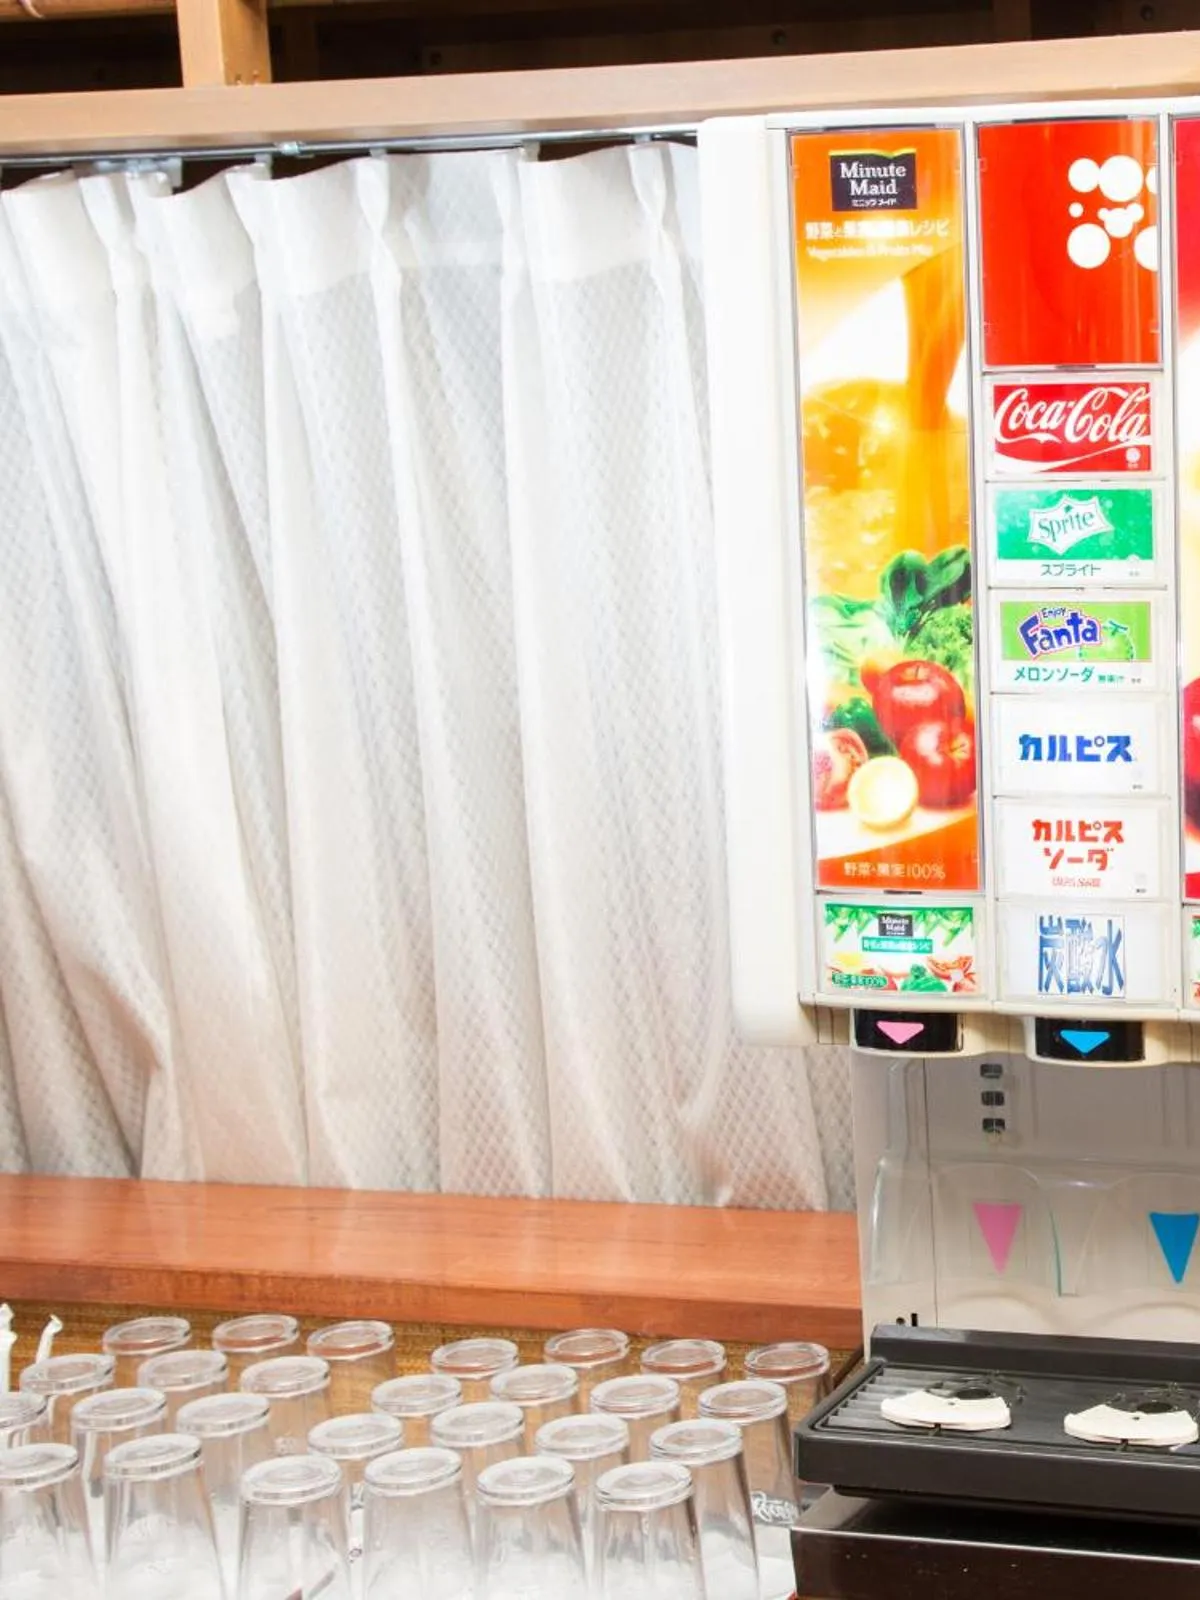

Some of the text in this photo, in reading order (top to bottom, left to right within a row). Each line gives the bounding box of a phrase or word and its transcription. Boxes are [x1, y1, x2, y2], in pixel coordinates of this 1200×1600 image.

[840, 161, 907, 178] Minute
[850, 178, 898, 196] Maid
[994, 386, 1152, 444] Coca-Cola
[1038, 506, 1096, 543] Sprite
[1041, 563, 1102, 577] スプライト
[1041, 607, 1066, 619] Enjoy
[1019, 611, 1099, 656] Fanta
[1014, 666, 1095, 683] メロンソーダ
[1019, 733, 1134, 762] カルピス
[1032, 819, 1124, 843] カルピス
[1043, 847, 1115, 872] ソーダ
[1038, 914, 1125, 996] 炭酸水
